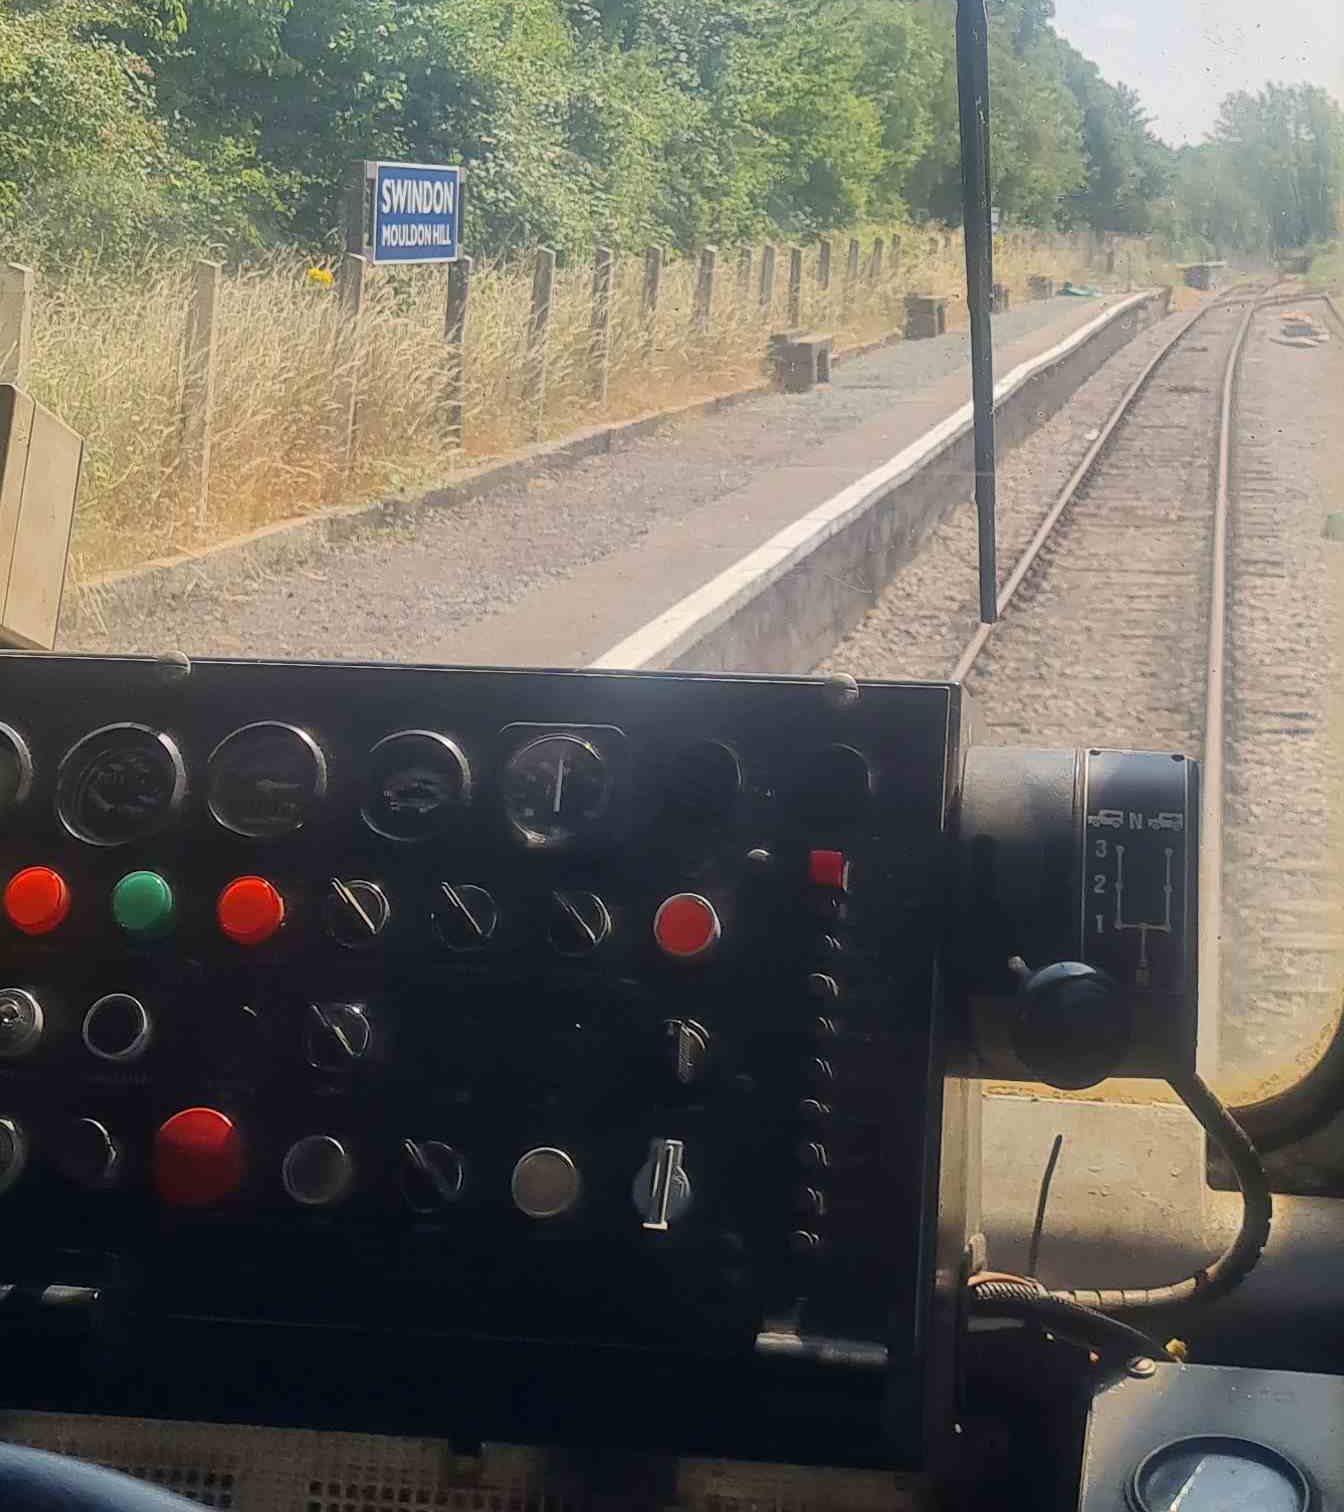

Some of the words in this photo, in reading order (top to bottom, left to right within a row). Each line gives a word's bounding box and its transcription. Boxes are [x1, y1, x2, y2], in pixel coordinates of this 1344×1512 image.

[382, 178, 454, 215] SWINDON
[382, 223, 432, 246] MOULDON
[433, 223, 452, 245] HILL
[1128, 812, 1144, 831] N
[1094, 839, 1107, 859] 3
[1093, 874, 1106, 894] 2
[1095, 914, 1105, 934] 1
